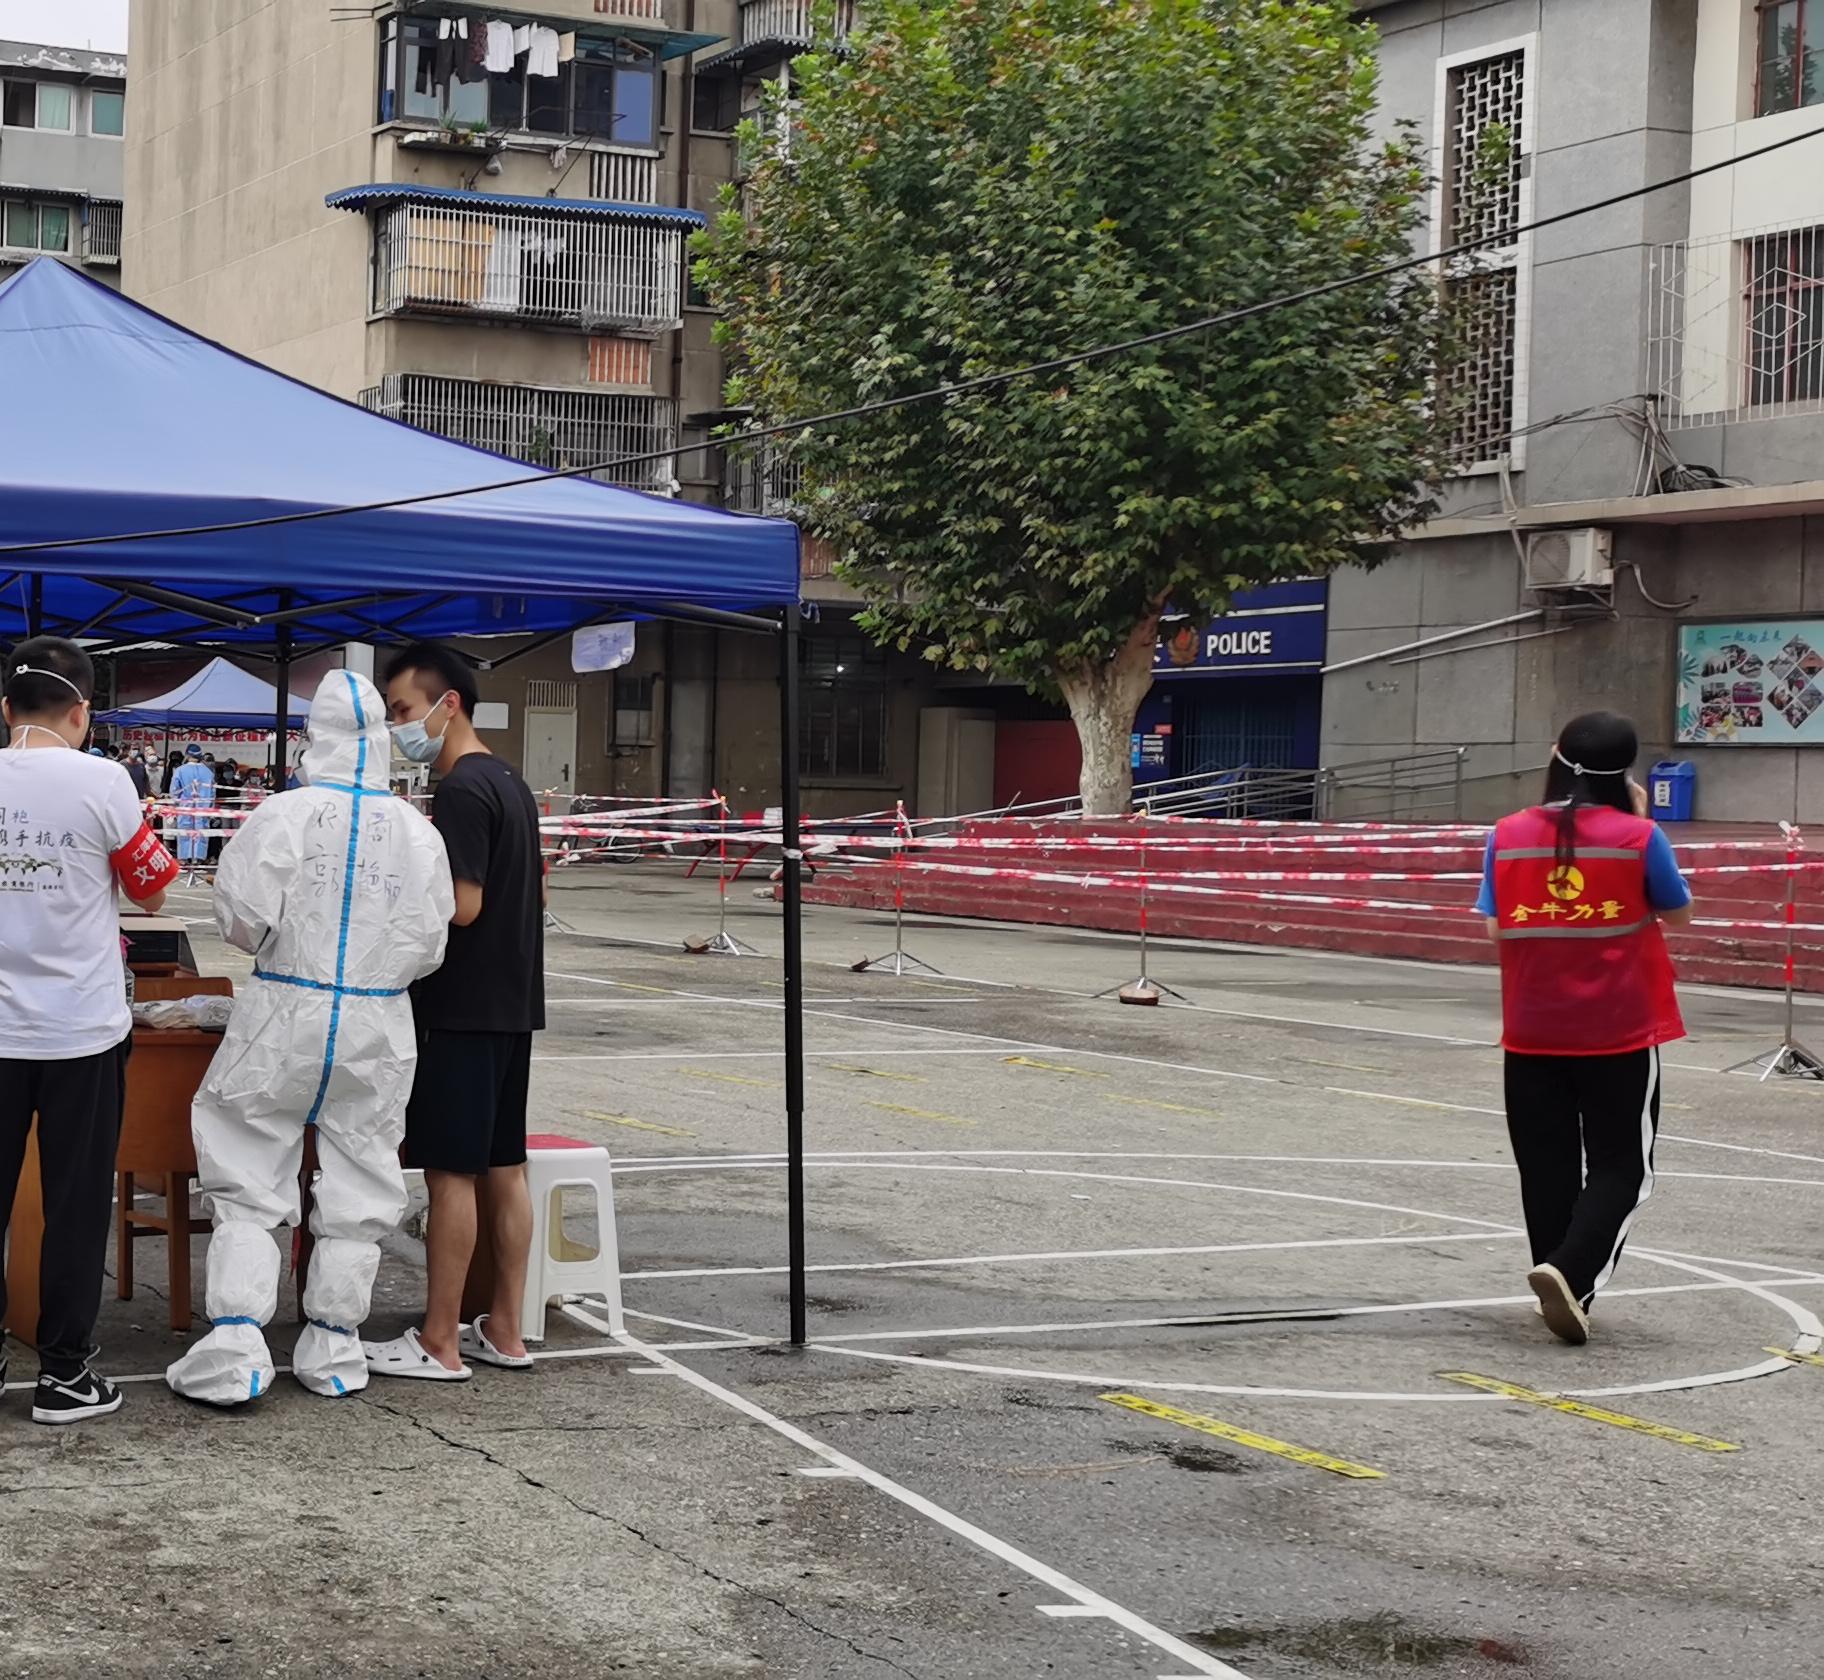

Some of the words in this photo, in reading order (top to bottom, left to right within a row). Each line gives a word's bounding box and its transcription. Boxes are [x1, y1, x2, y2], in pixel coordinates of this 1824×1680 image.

[1206, 631, 1272, 657] POLICE
[132, 843, 175, 886] 文明
[1509, 900, 1625, 922] 金牛力量
